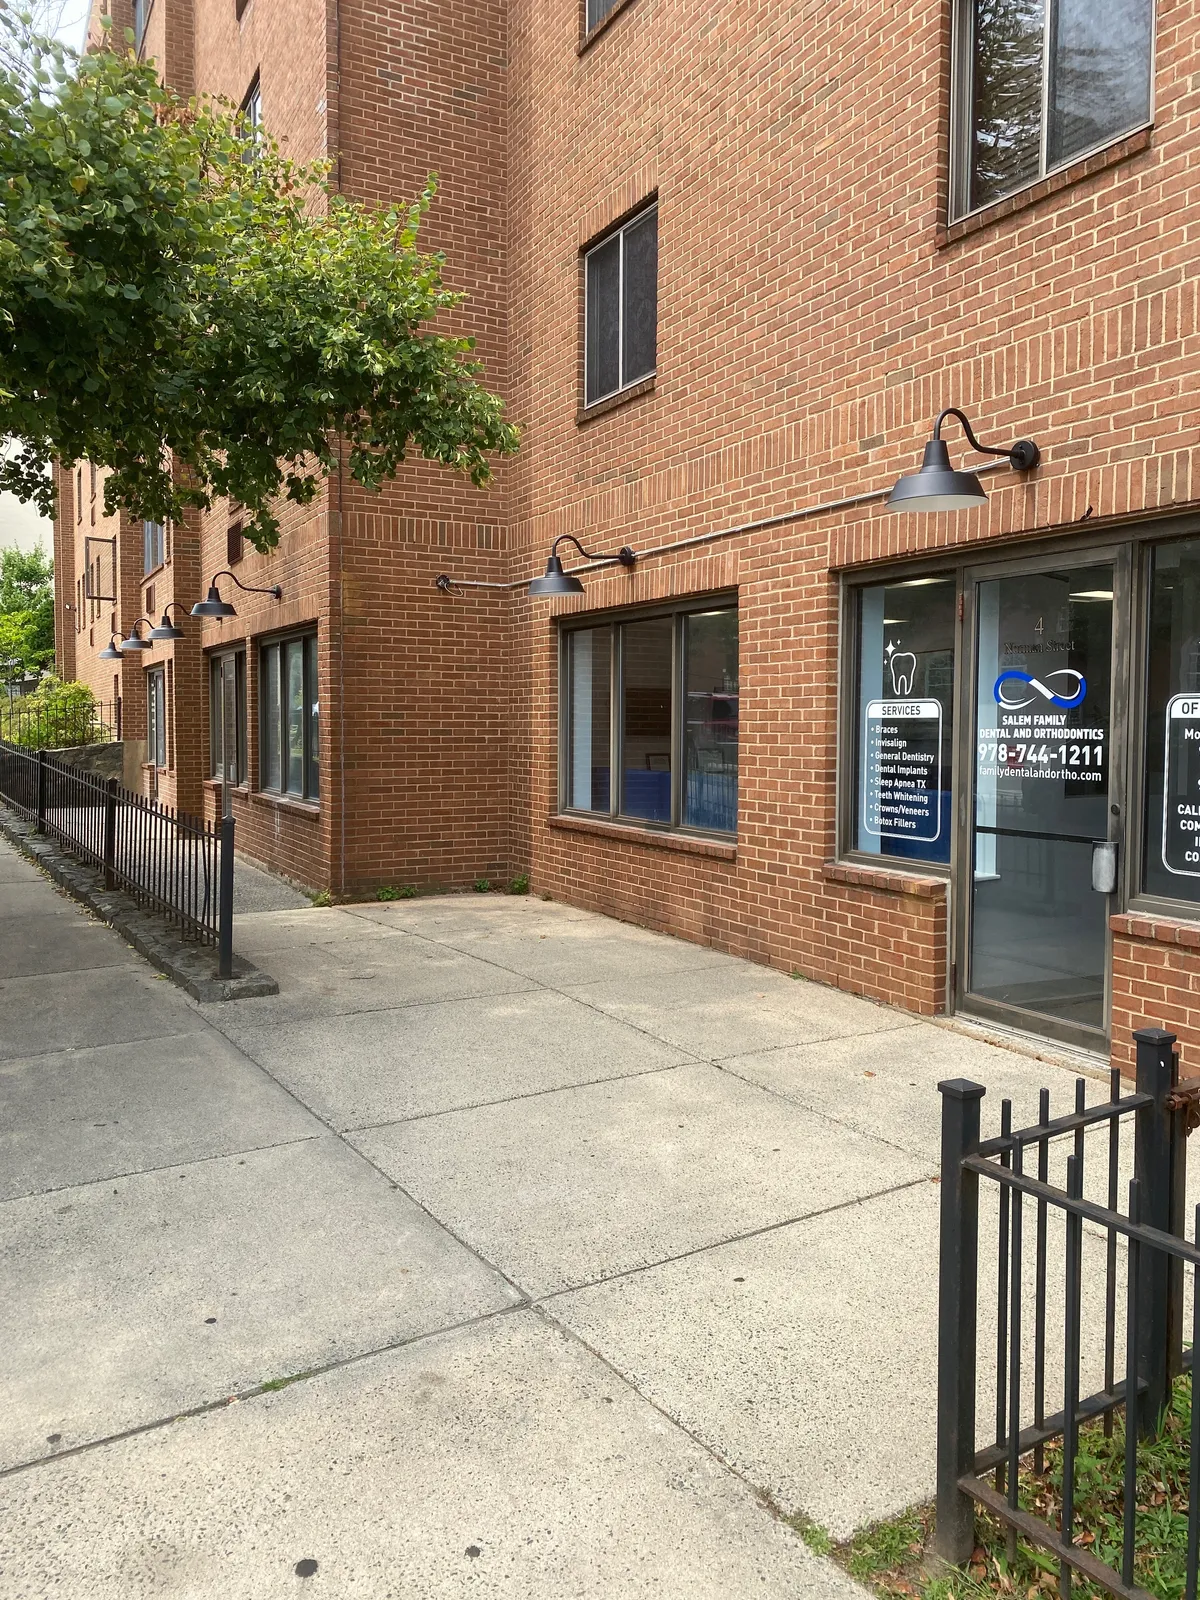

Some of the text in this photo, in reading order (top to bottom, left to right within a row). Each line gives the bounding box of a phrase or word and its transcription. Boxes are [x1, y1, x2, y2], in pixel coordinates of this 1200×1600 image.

[1034, 616, 1044, 635] 4
[1046, 640, 1075, 652] Street
[882, 706, 921, 716] SERVICES
[1002, 714, 1067, 726] SALEM FAMILY
[875, 725, 898, 734] Braces
[979, 728, 1104, 740] DENTAL AND ORTHODONTICS
[875, 738, 907, 749] Invisalign
[875, 752, 934, 764] General Dentistry
[978, 743, 1103, 766] 978-744-1211
[875, 764, 928, 777] Dental Implants
[979, 766, 1102, 782] familydentalandortho.com
[874, 777, 926, 789] Sleep Apnea TX
[874, 790, 928, 804] Teeth Whitening
[874, 803, 930, 817] Crowns/Veneers
[1177, 804, 1200, 816] CAL
[874, 816, 917, 829] Botox Fillers
